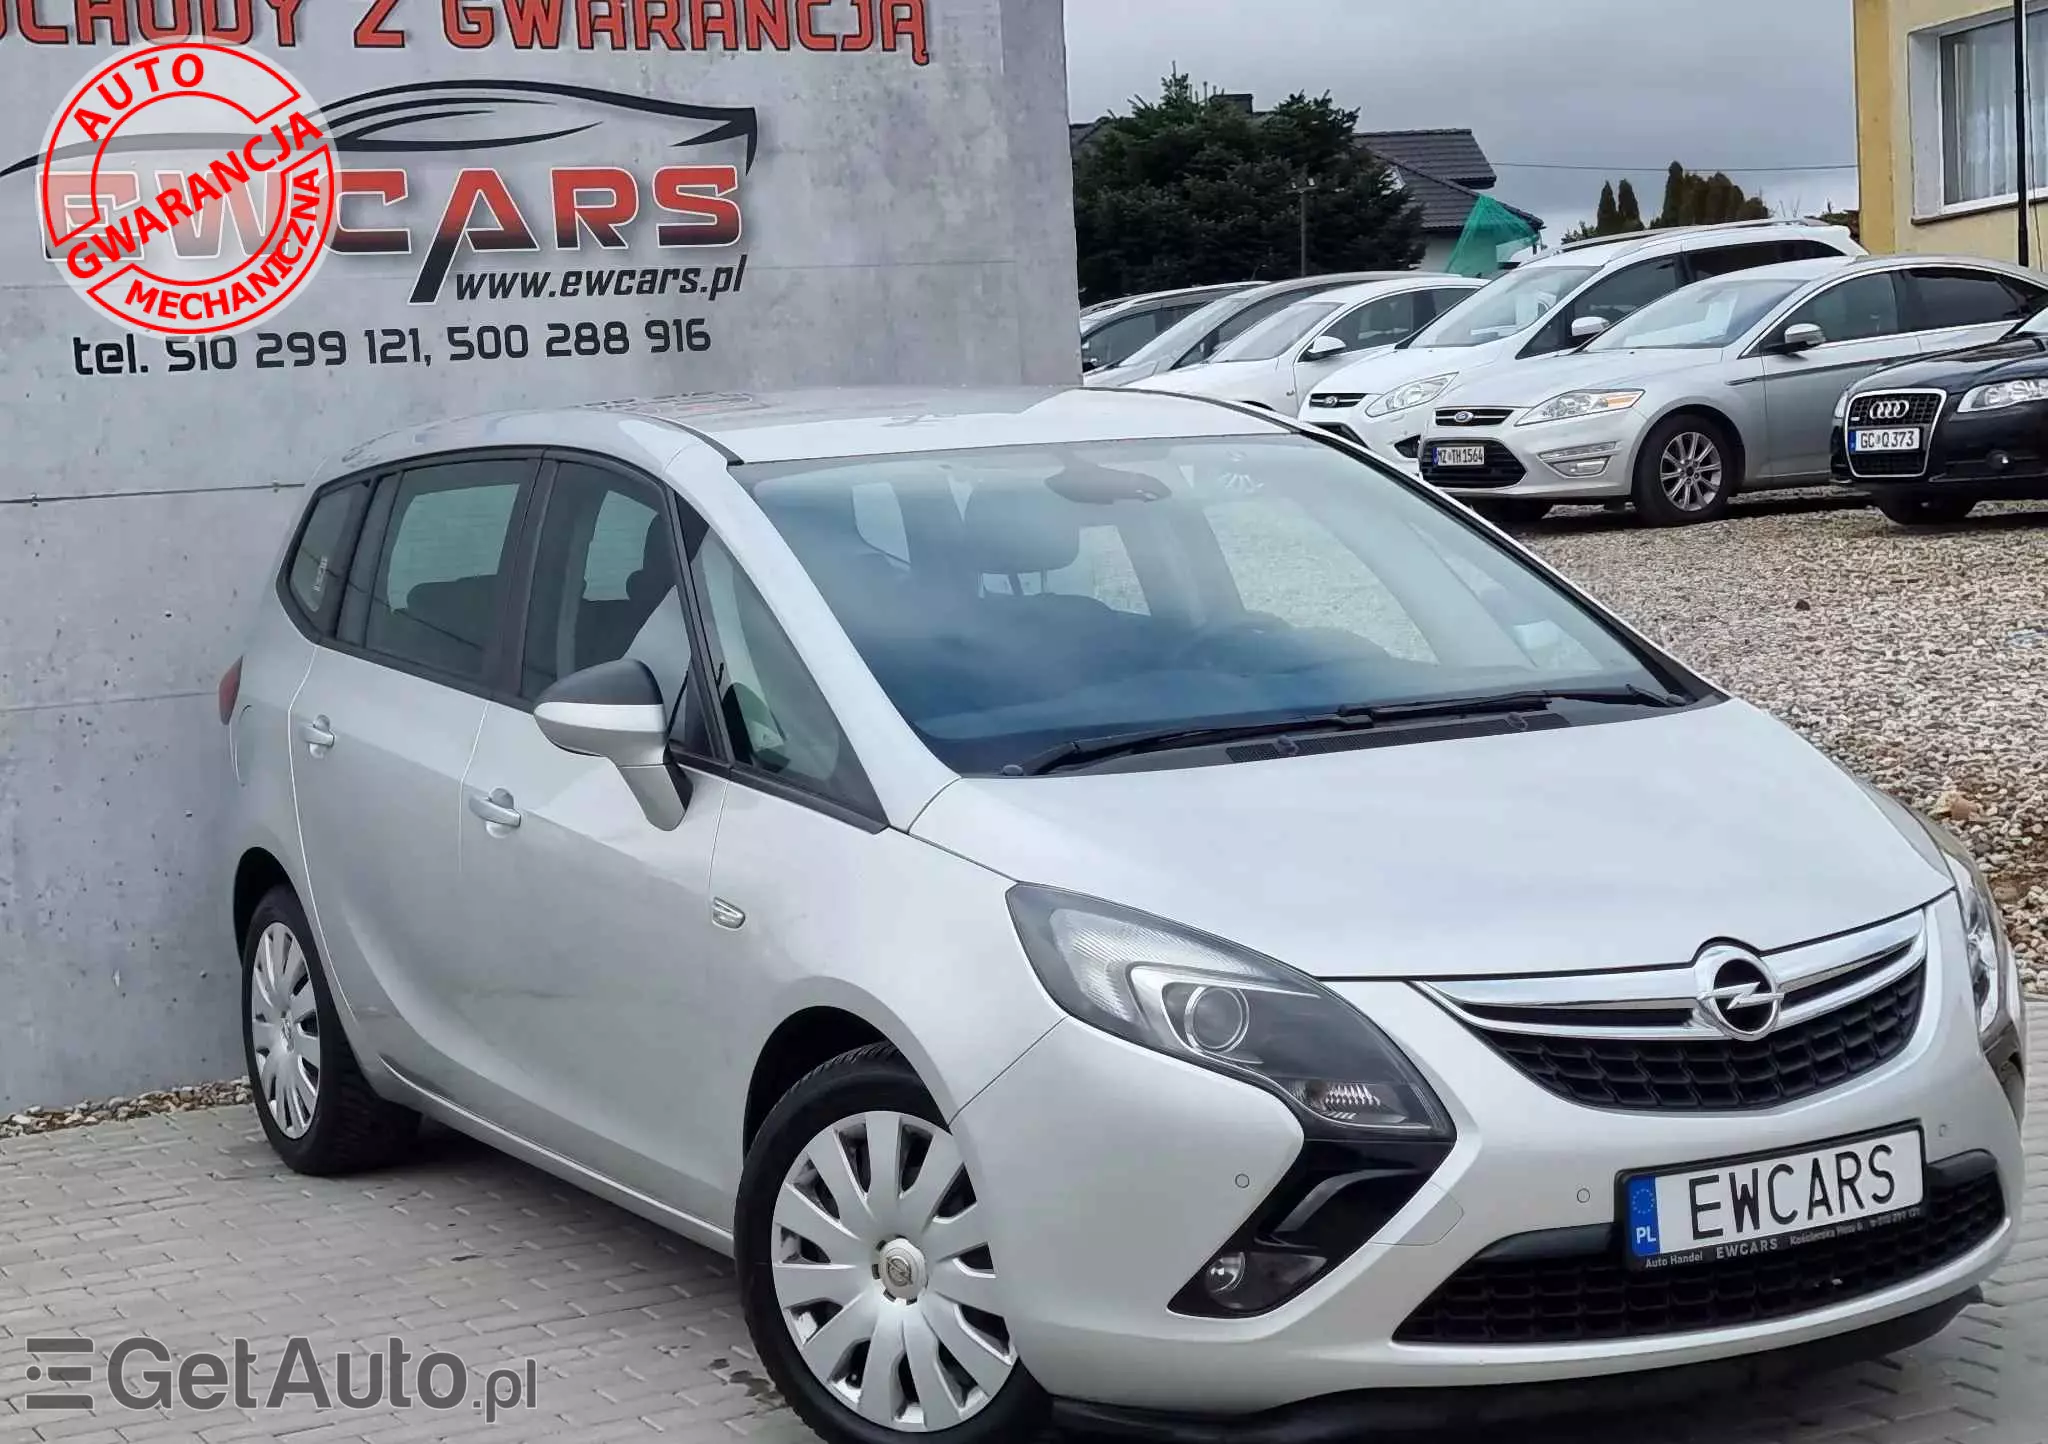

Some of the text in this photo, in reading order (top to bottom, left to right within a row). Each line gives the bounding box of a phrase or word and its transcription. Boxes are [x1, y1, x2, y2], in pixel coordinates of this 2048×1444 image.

[0, 0, 302, 46] CHODY
[442, 0, 930, 65] GWARANCJĄ
[37, 164, 742, 305] EWCARS
[455, 254, 748, 300] www.ewcars.pl
[73, 317, 712, 375] tel. 510 299 121, 500 288 916
[1688, 1144, 1896, 1241] EWCARS
[1635, 1226, 1657, 1244] PL
[1645, 1258, 1668, 1269] Auto
[1670, 1251, 1703, 1266] Handel
[1716, 1238, 1778, 1260] EWCARS
